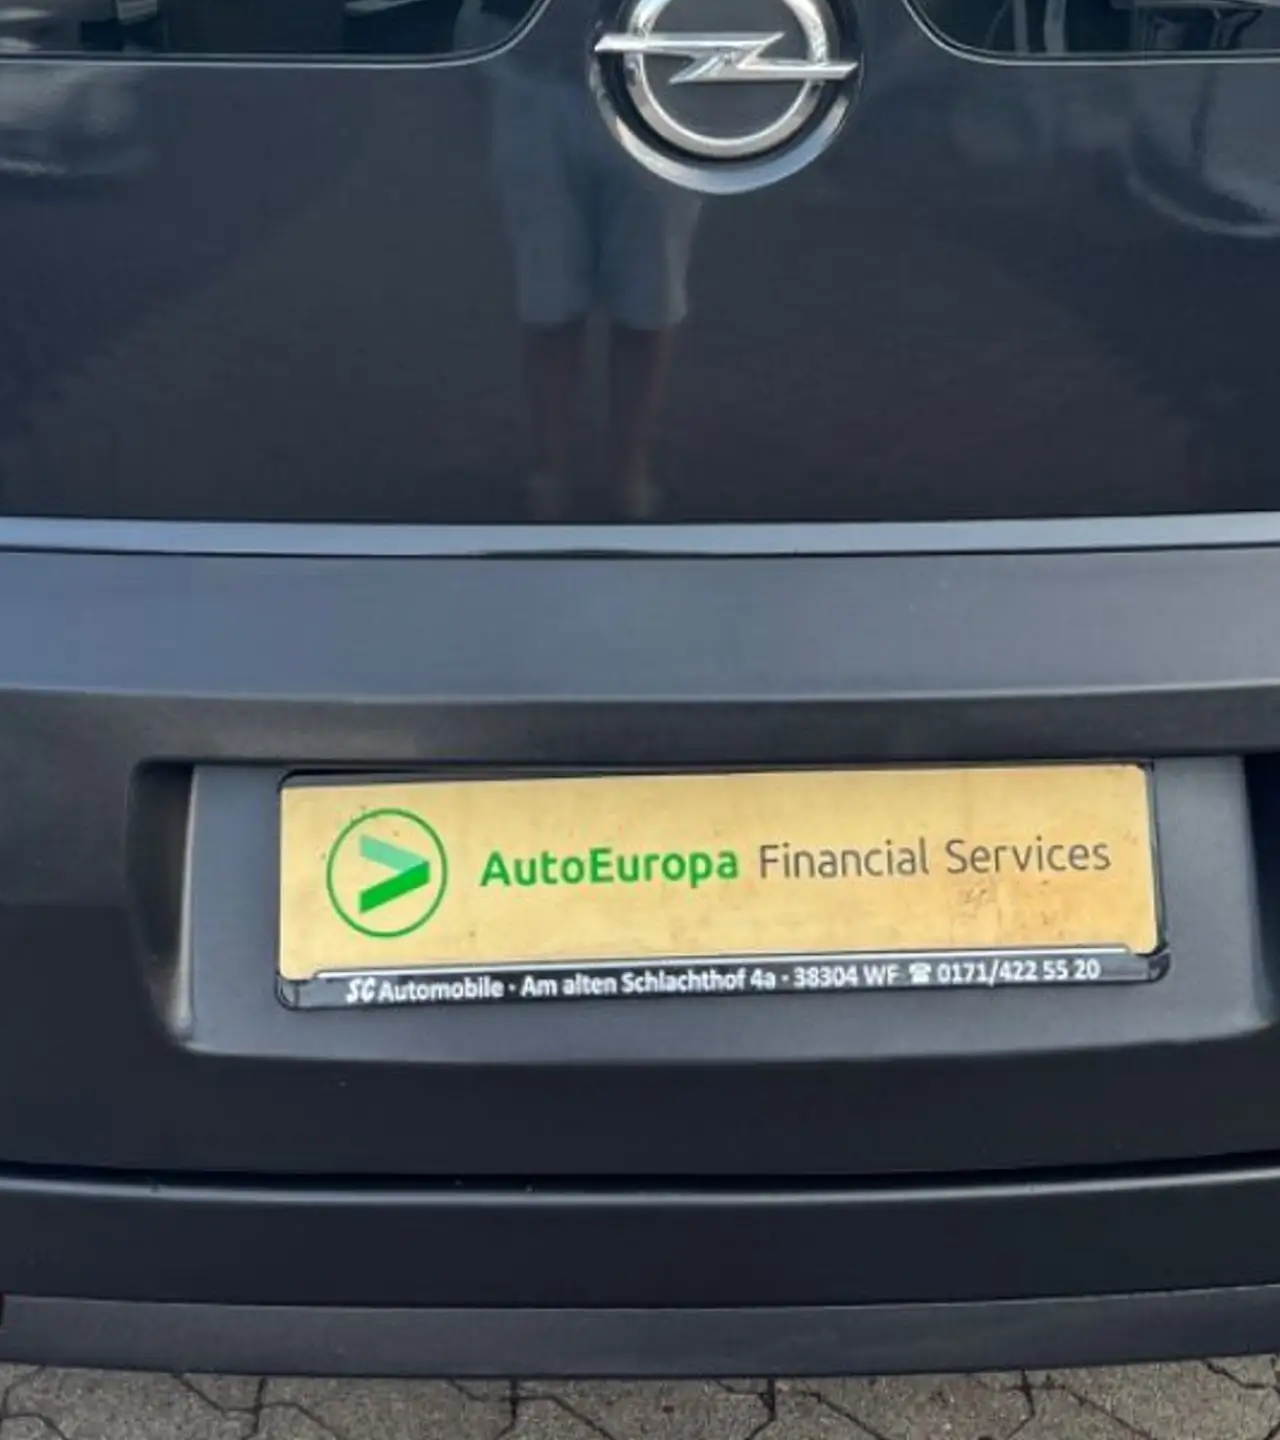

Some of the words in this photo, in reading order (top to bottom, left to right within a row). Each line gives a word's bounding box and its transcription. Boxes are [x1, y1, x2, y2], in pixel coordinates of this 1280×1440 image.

[479, 846, 740, 890] AutoEuropa
[757, 836, 930, 880] Financial
[944, 835, 1112, 875] Services
[377, 974, 506, 1002] Automobile
[519, 974, 558, 999] Am
[562, 972, 618, 997] alten
[621, 967, 746, 994] Schlachthof
[750, 967, 777, 991] 4a
[792, 965, 859, 990] 38304
[863, 964, 900, 988] WF
[936, 959, 1038, 988] 0171/422
[1042, 959, 1069, 983] 55
[1071, 958, 1102, 981] 20
